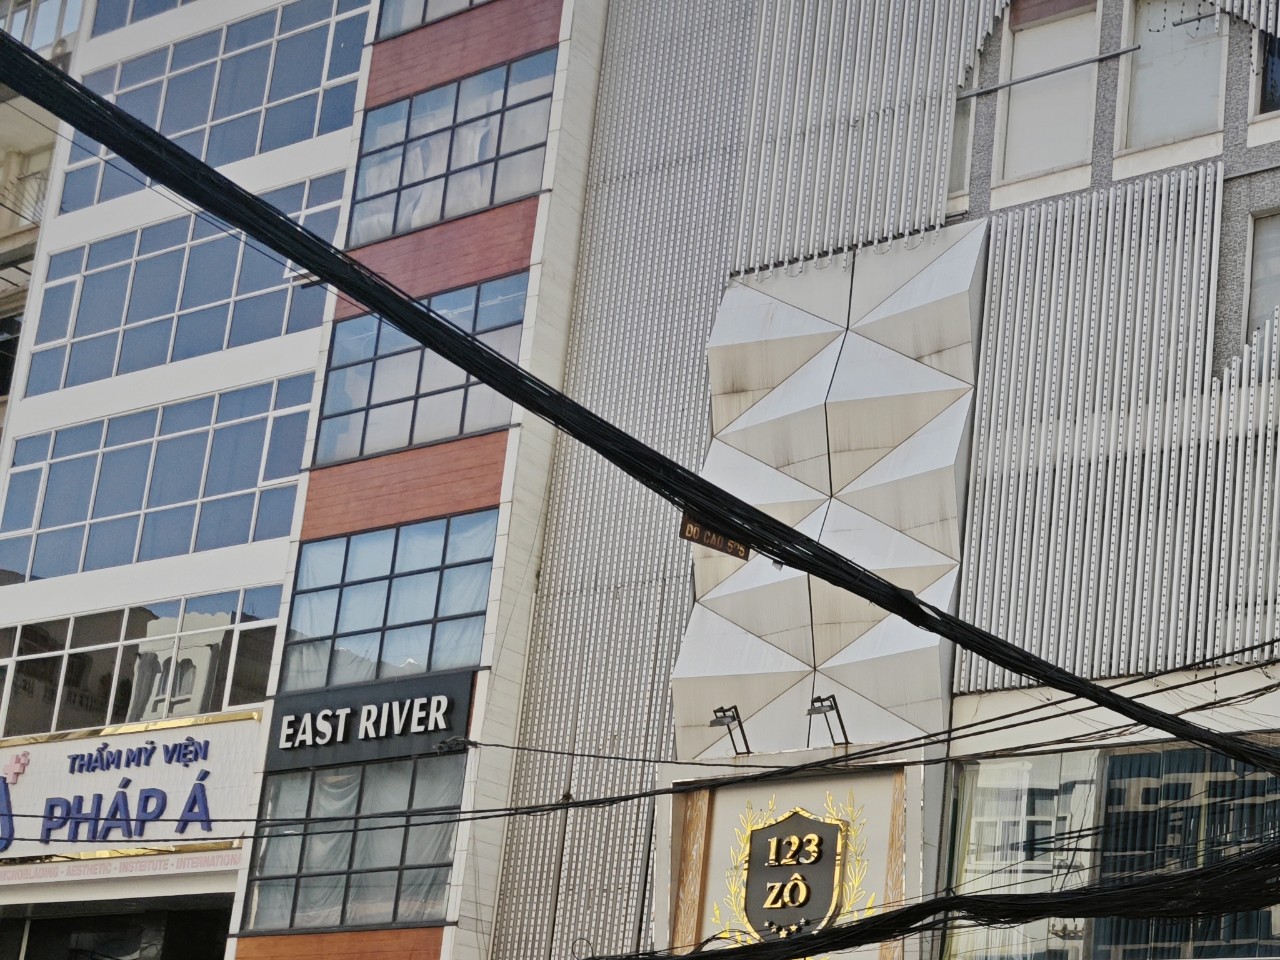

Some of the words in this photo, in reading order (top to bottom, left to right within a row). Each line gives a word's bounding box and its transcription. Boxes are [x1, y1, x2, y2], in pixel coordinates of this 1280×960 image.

[278, 707, 352, 750] EAST
[357, 694, 449, 741] RIVER
[67, 742, 122, 775] THẨM
[162, 736, 211, 768] VIỆN
[40, 776, 168, 845] PHÁP
[174, 768, 213, 835] Á
[764, 832, 821, 867] 123
[762, 872, 811, 910] ZÔ
